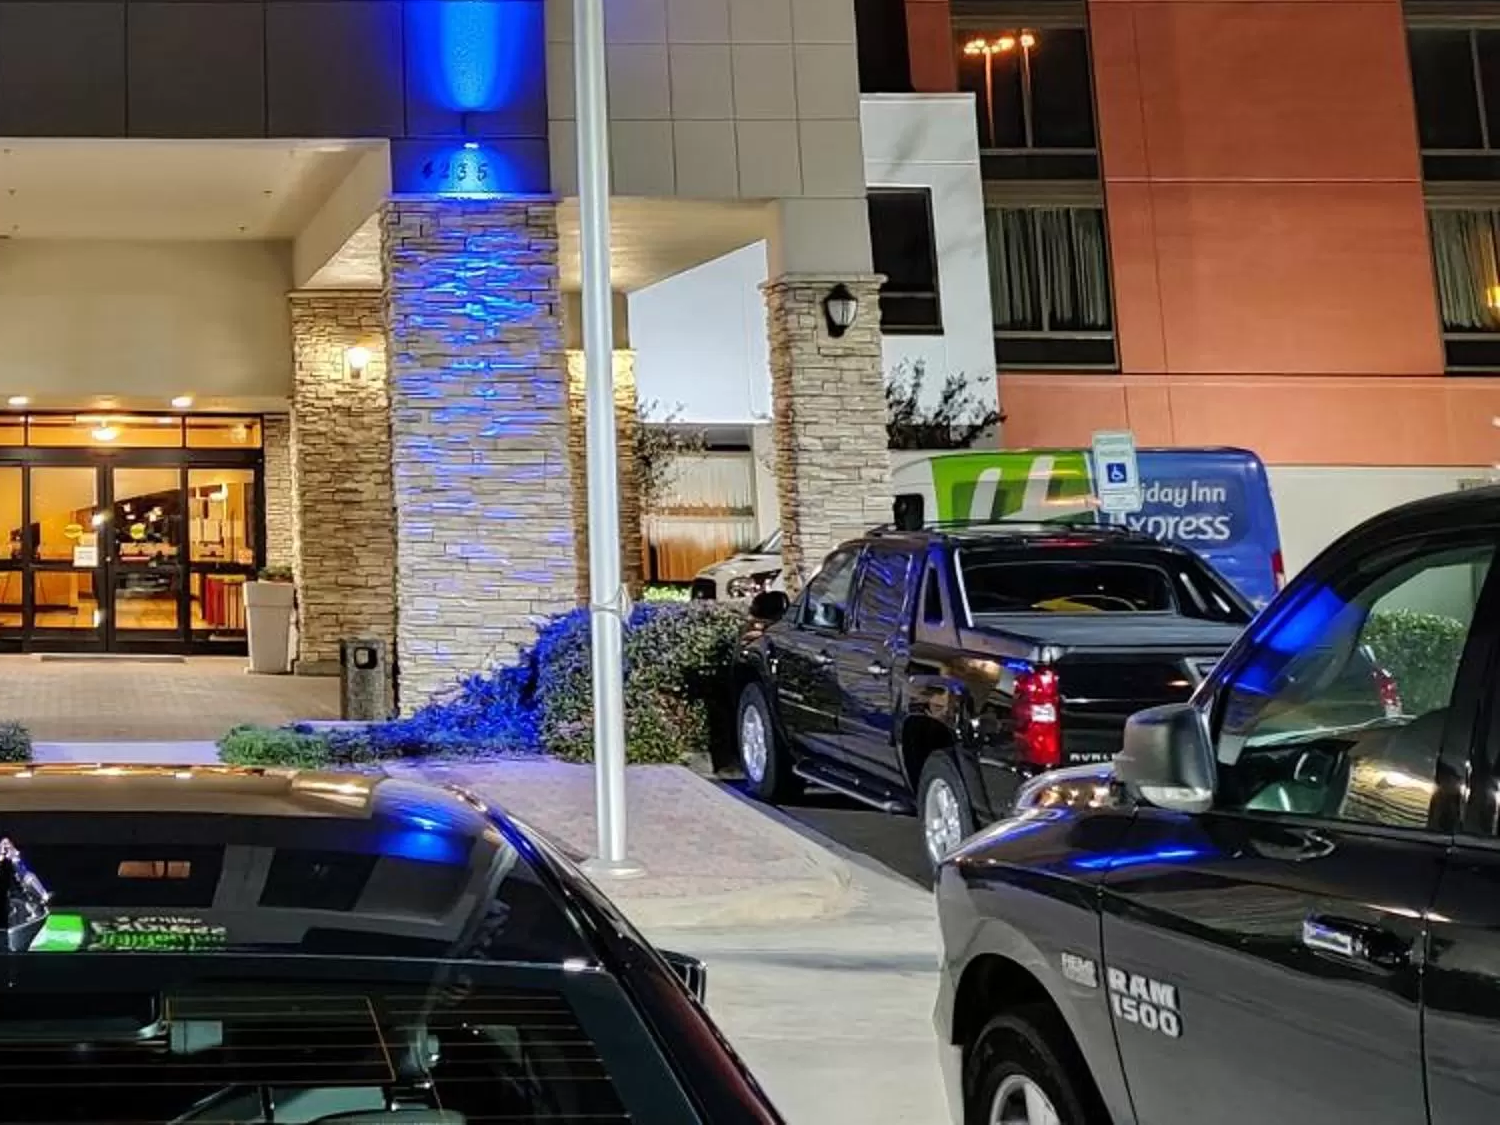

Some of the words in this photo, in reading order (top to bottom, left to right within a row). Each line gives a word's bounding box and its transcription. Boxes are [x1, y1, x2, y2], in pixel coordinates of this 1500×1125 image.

[1140, 480, 1191, 508] iday
[1191, 480, 1227, 503] Inn
[1122, 513, 1231, 542] xpress
[1107, 967, 1176, 1009] RAM
[1111, 993, 1180, 1038] 1500
